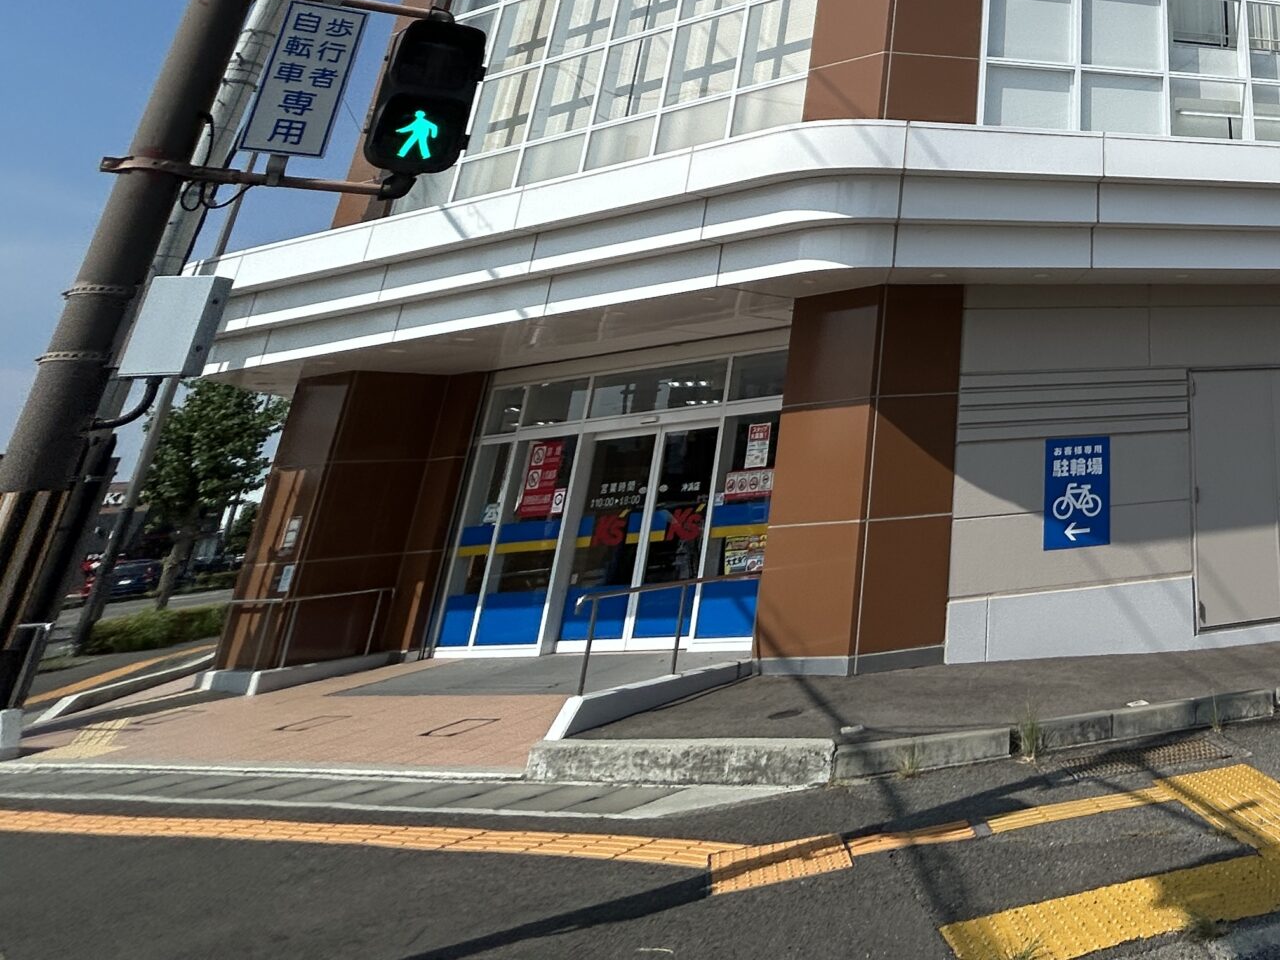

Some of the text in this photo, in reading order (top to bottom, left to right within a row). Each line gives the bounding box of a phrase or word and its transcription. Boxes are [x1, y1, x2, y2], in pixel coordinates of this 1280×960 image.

[273, 12, 320, 84] 自転車
[308, 18, 354, 89] 歩行者
[267, 89, 318, 146] 専用
[1052, 457, 1103, 478] 駐輪場
[1053, 444, 1102, 457] お客様専用
